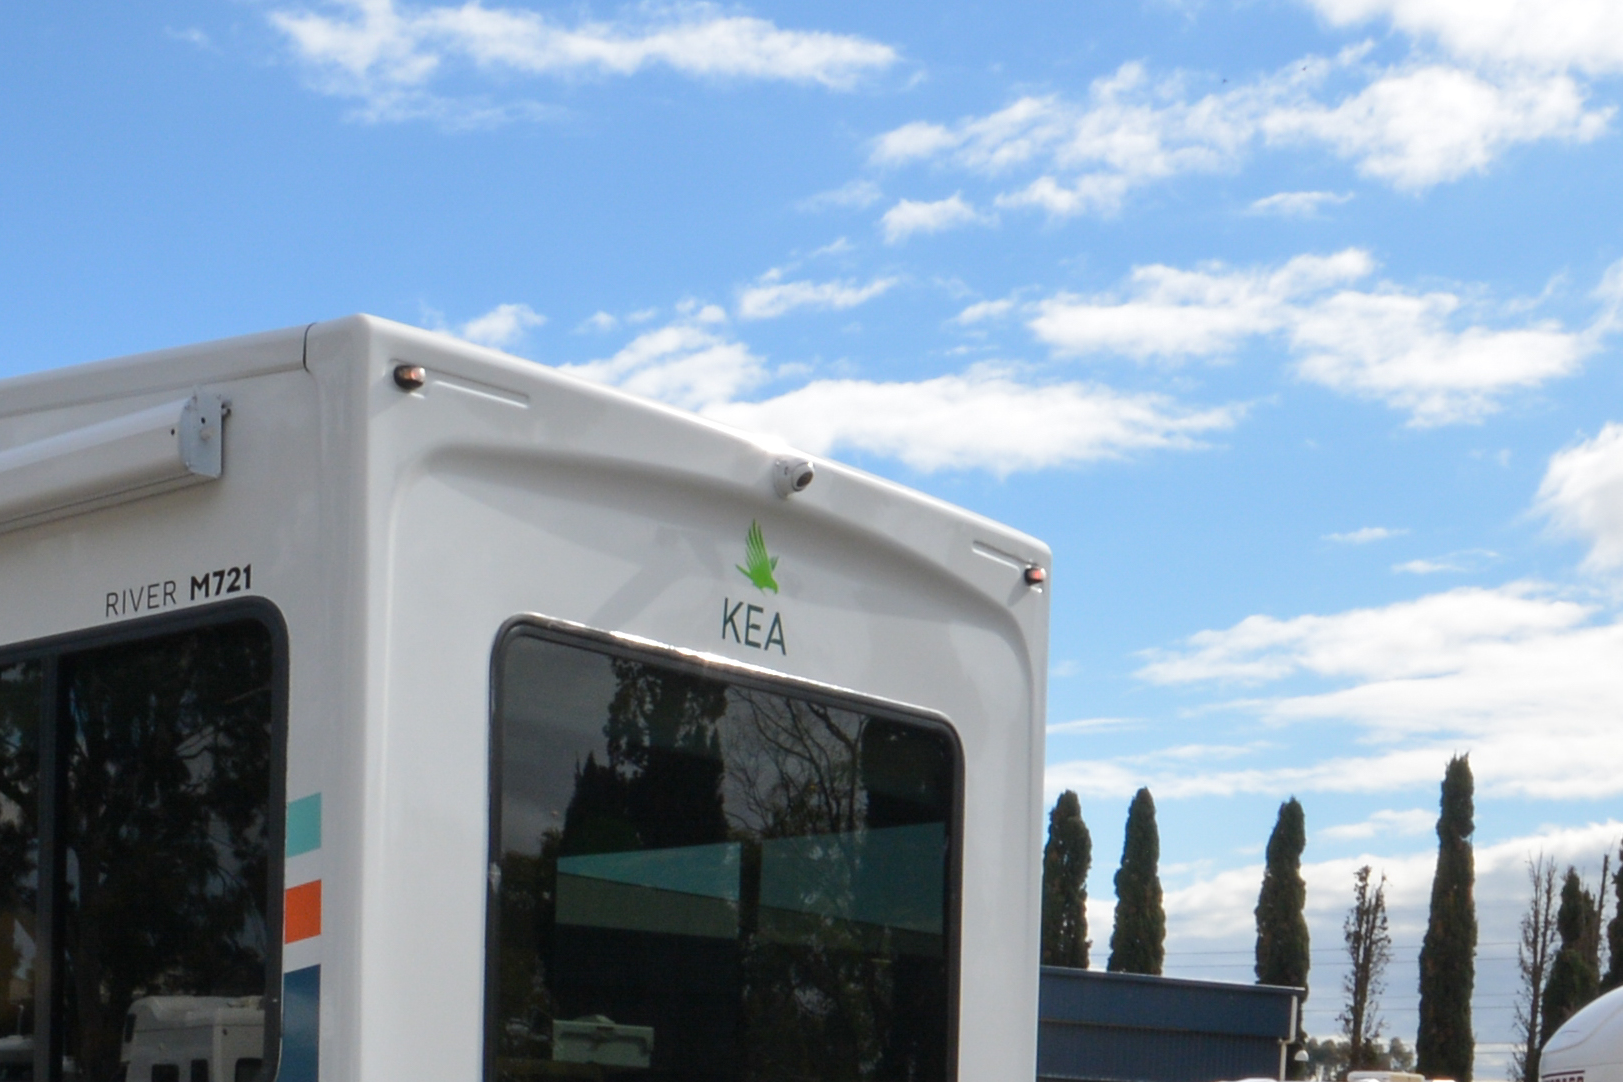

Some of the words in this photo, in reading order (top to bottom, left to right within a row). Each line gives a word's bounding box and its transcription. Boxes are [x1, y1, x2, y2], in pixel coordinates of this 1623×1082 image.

[105, 580, 177, 617] RIVER
[189, 563, 252, 601] M721
[721, 597, 788, 656] KEA
